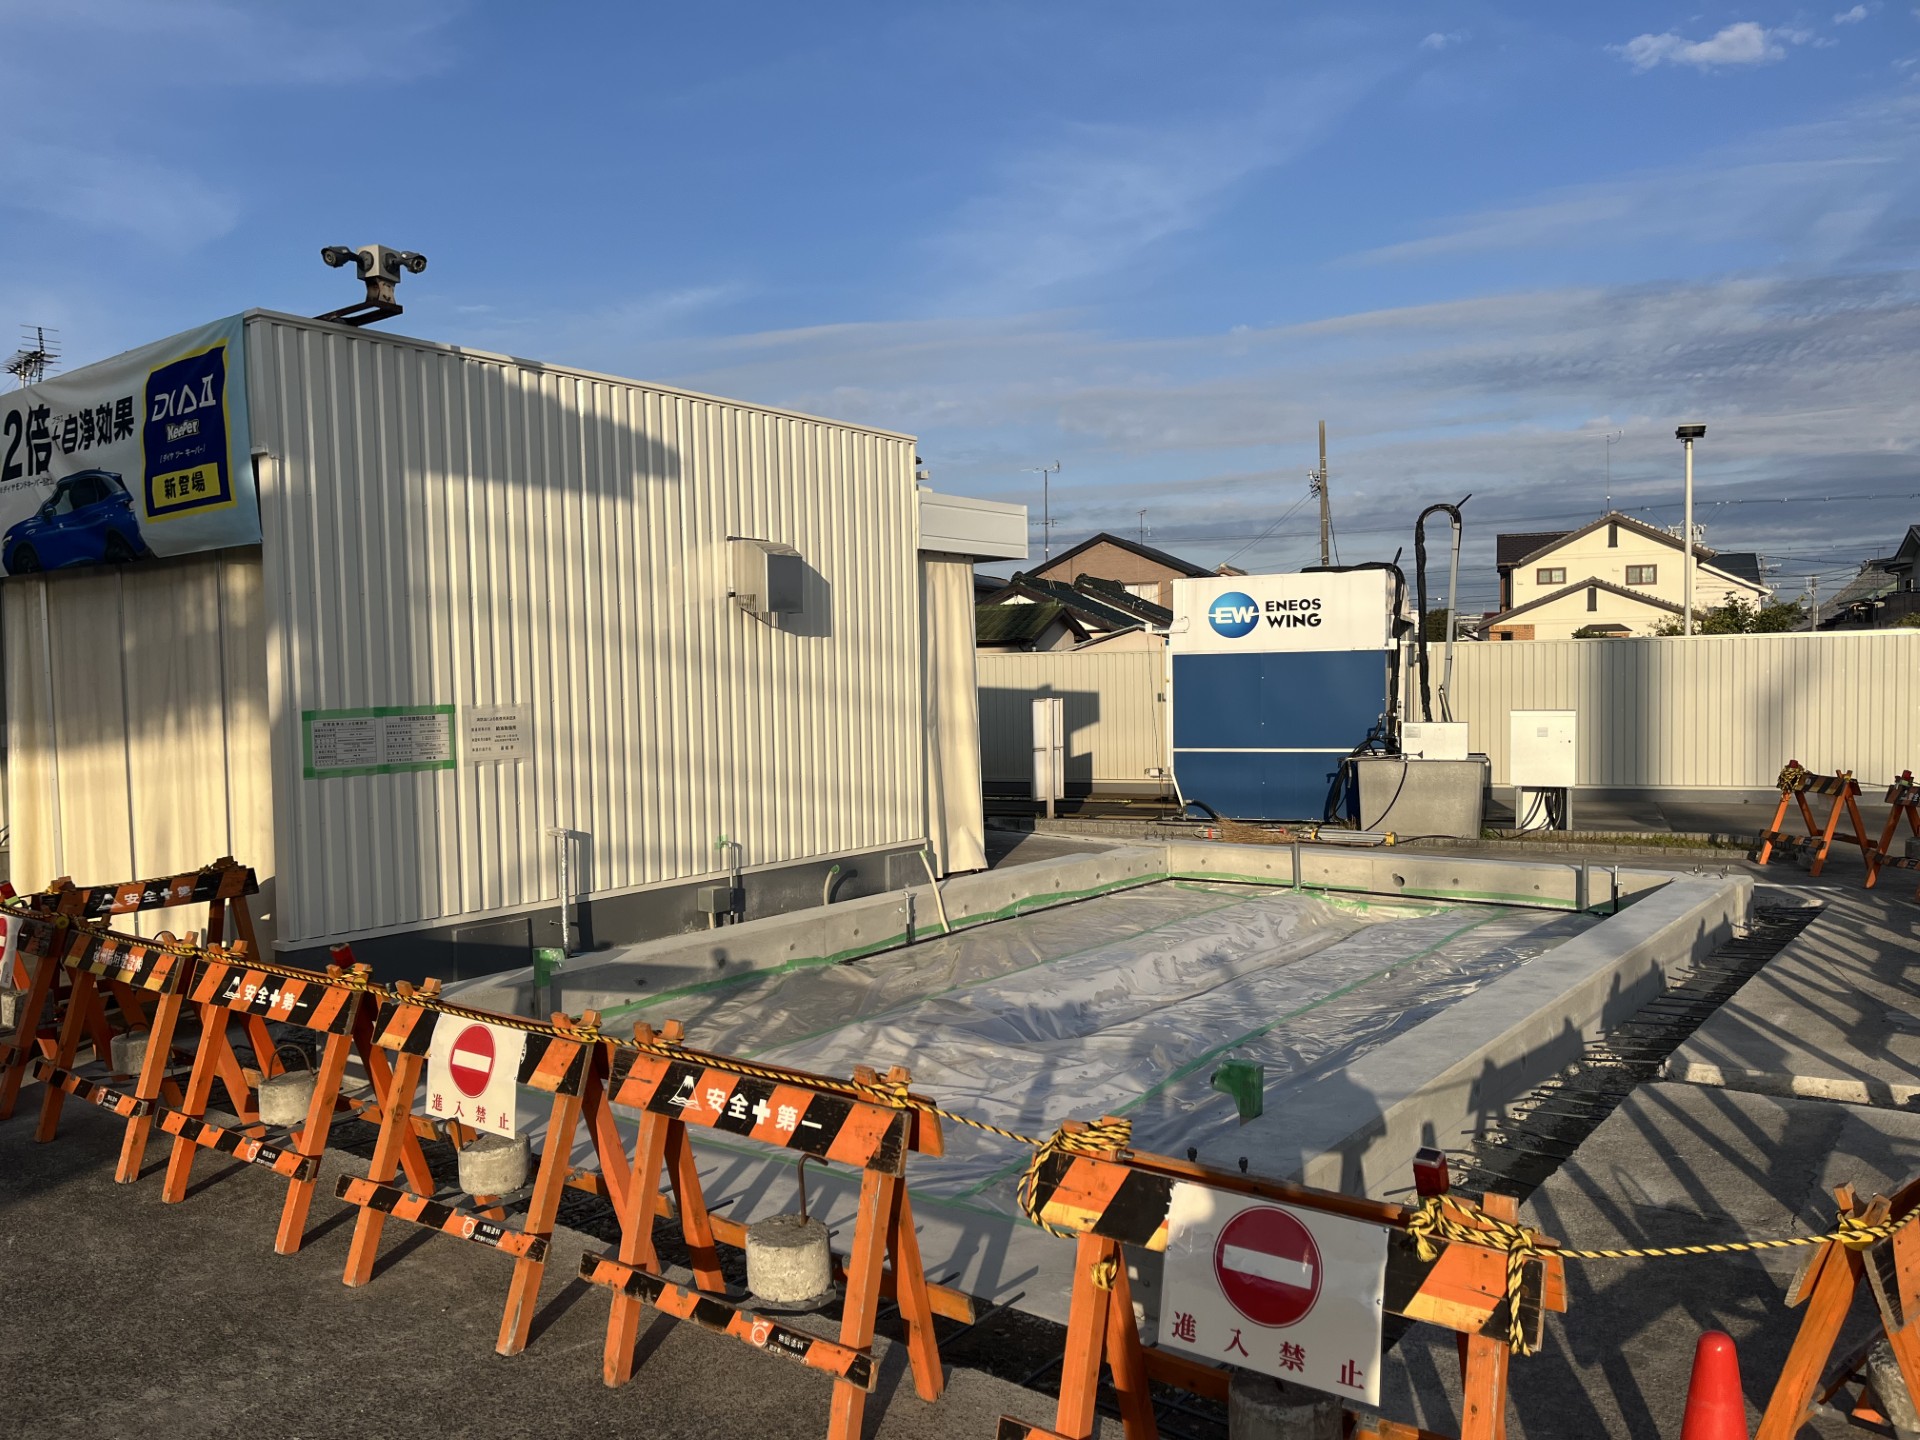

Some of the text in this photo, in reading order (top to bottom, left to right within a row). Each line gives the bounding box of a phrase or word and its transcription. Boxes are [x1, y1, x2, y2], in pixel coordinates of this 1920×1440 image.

[164, 470, 206, 500] 新登場
[1215, 606, 1255, 624] EW
[1265, 598, 1322, 612] ENEOS
[1266, 613, 1322, 629] WING
[243, 983, 308, 1011] 安全 第一
[431, 1093, 509, 1131] 進入禁止
[706, 1087, 822, 1131] 安全 第一
[1171, 1310, 1365, 1391] 進入禁止
